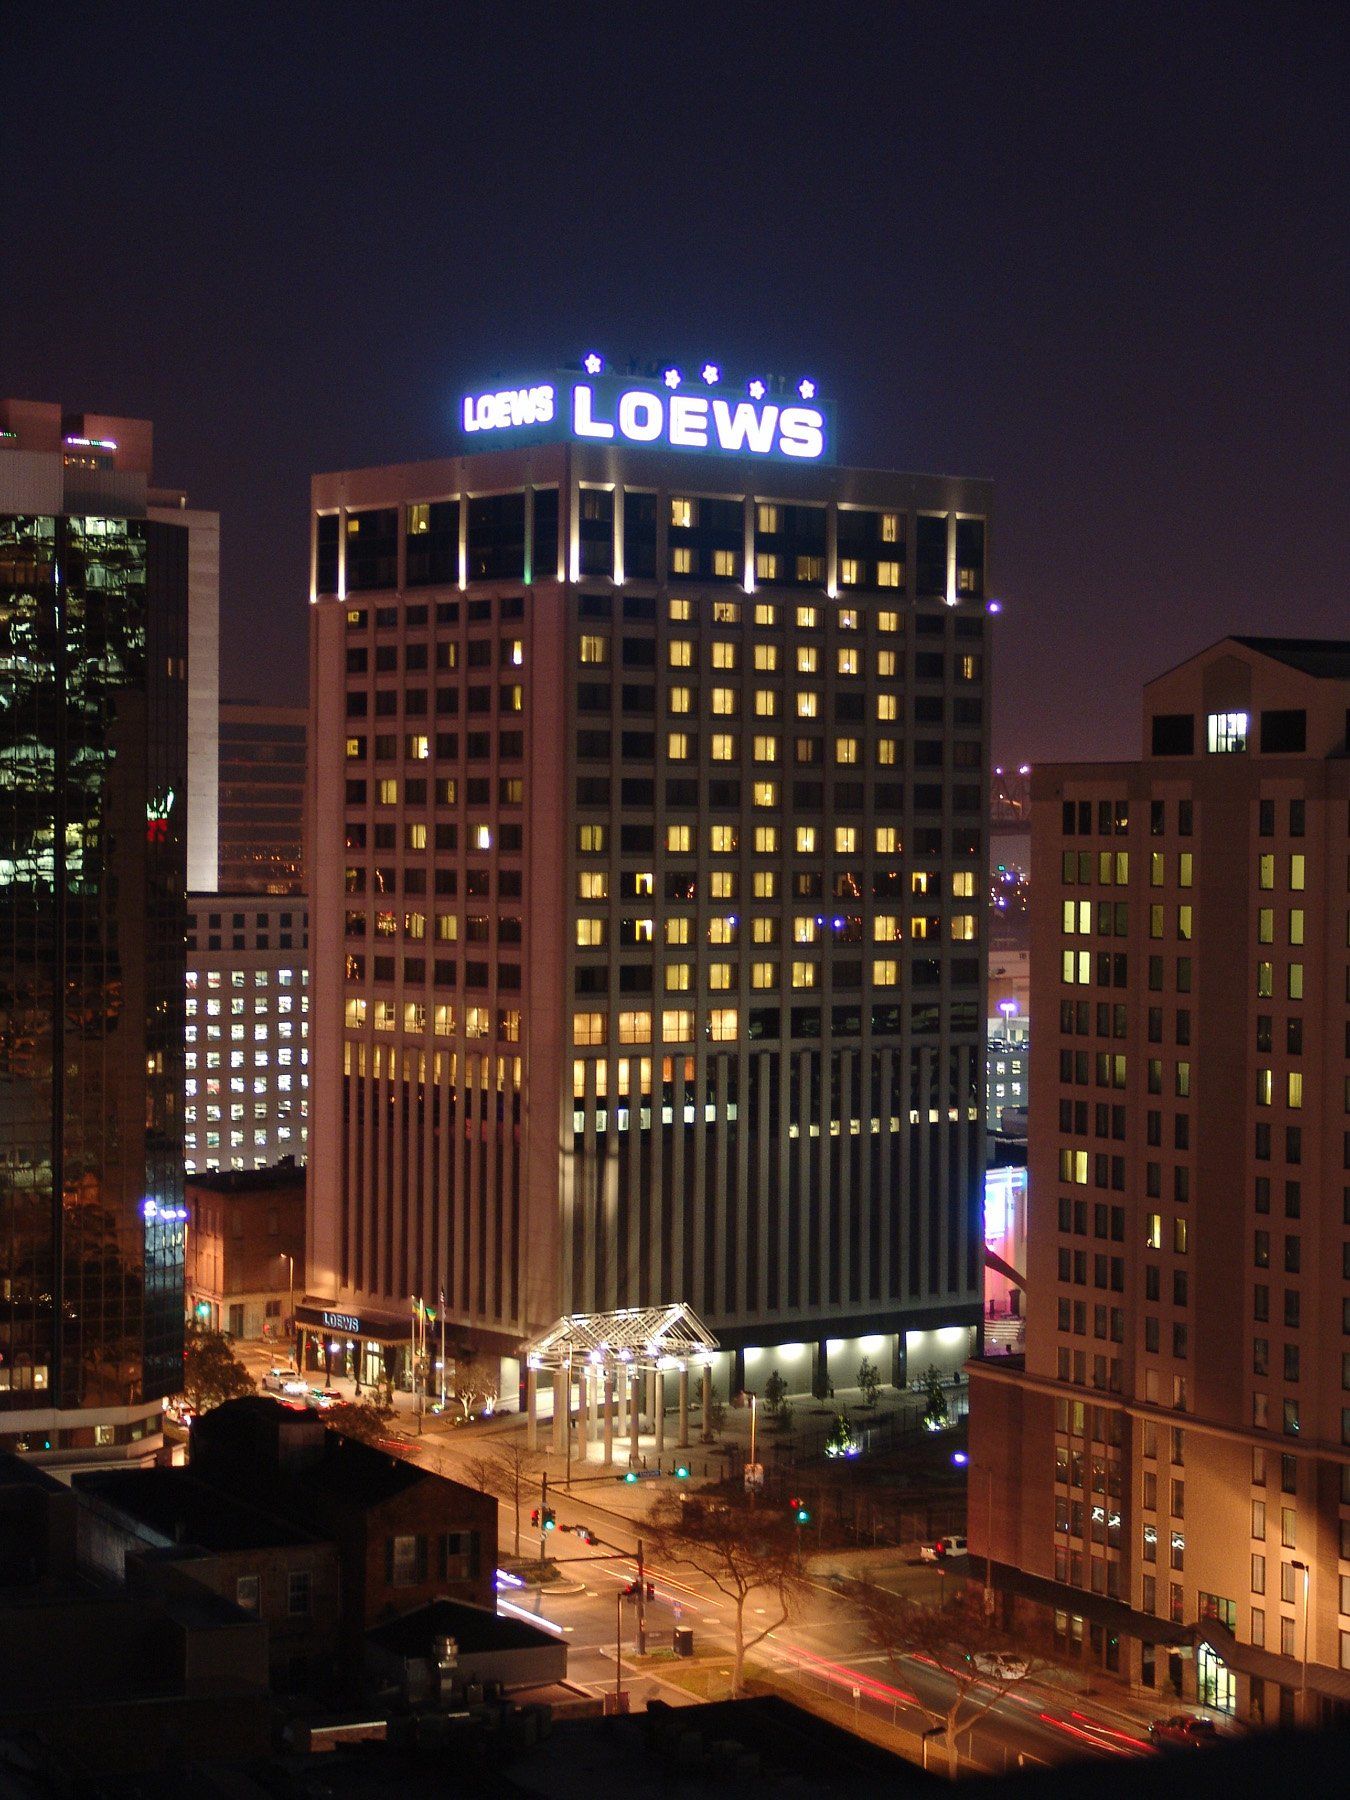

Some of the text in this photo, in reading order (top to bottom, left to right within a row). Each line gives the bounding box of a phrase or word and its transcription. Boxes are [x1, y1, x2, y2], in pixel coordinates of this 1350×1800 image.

[464, 385, 554, 432] LOEWS
[574, 385, 824, 458] LOEWS
[324, 1312, 359, 1332] LOEWS
